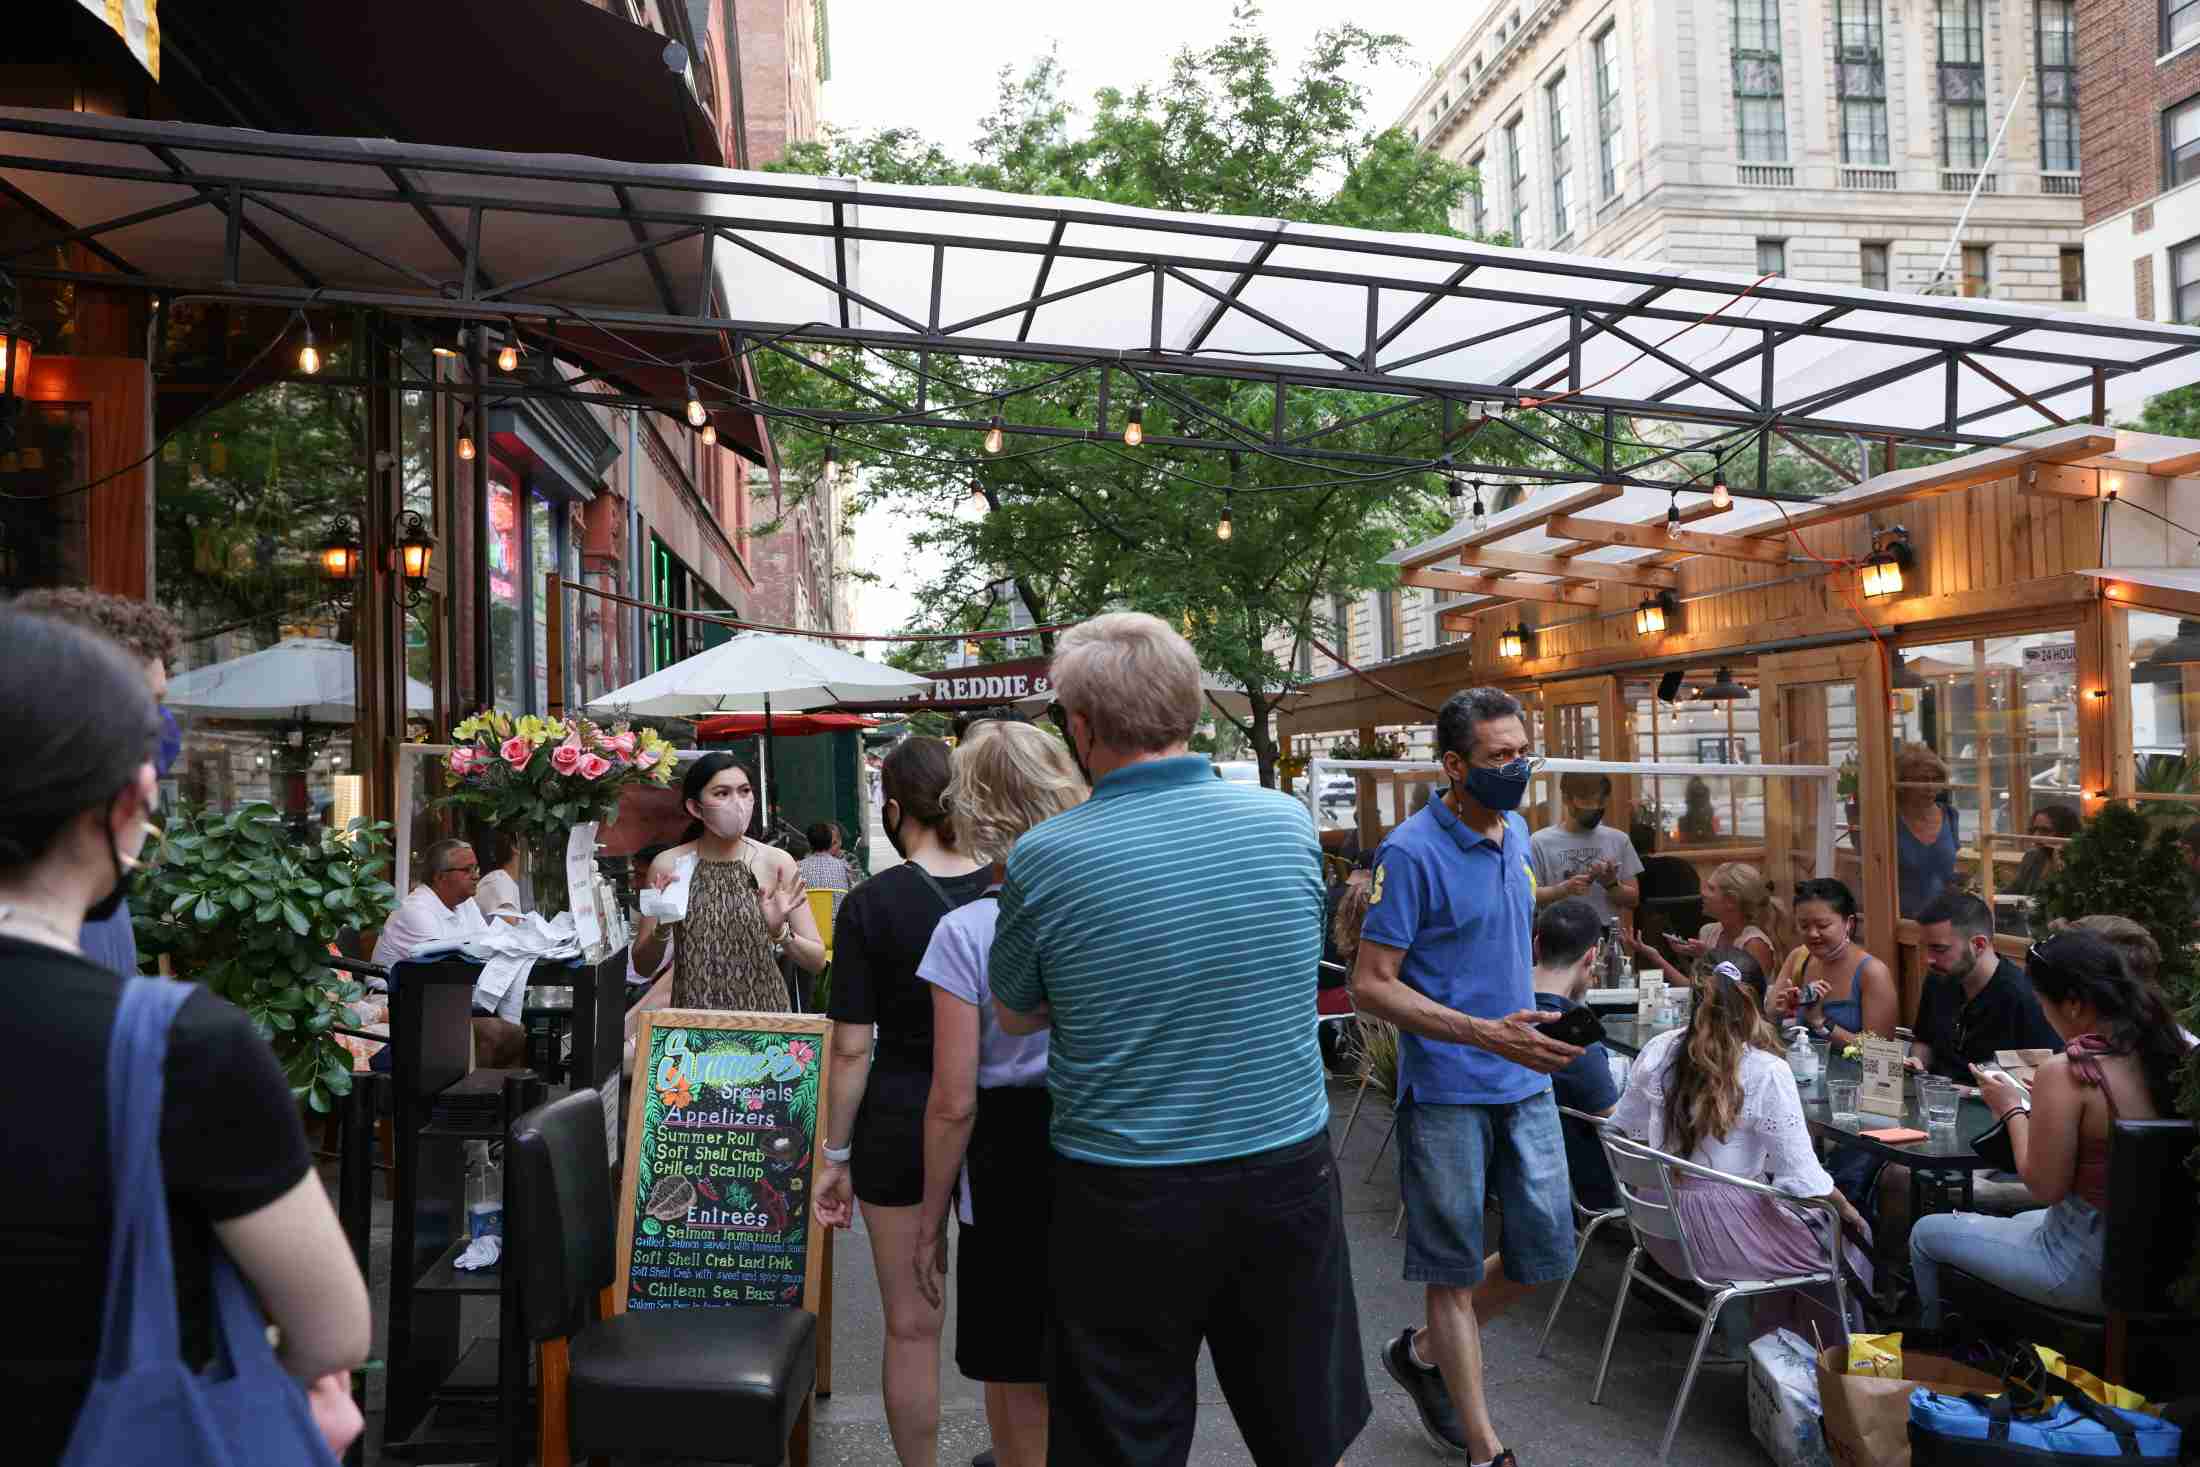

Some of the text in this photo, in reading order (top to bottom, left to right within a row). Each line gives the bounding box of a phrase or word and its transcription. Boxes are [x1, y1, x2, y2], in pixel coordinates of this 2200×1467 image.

[1034, 677, 1048, 693] &
[721, 1080, 793, 1104] Specials
[664, 1103, 777, 1128] Appetizers
[656, 1125, 755, 1146] Summer Roll
[656, 1143, 766, 1164] Soft Shell Crab
[653, 1161, 764, 1182] Grilled Scallop
[666, 1225, 715, 1241] Salmon
[633, 1250, 661, 1265] Soft
[667, 1251, 700, 1266] Shell
[705, 1252, 735, 1267] Crab
[648, 1281, 776, 1301] Chilean Sea Bass
